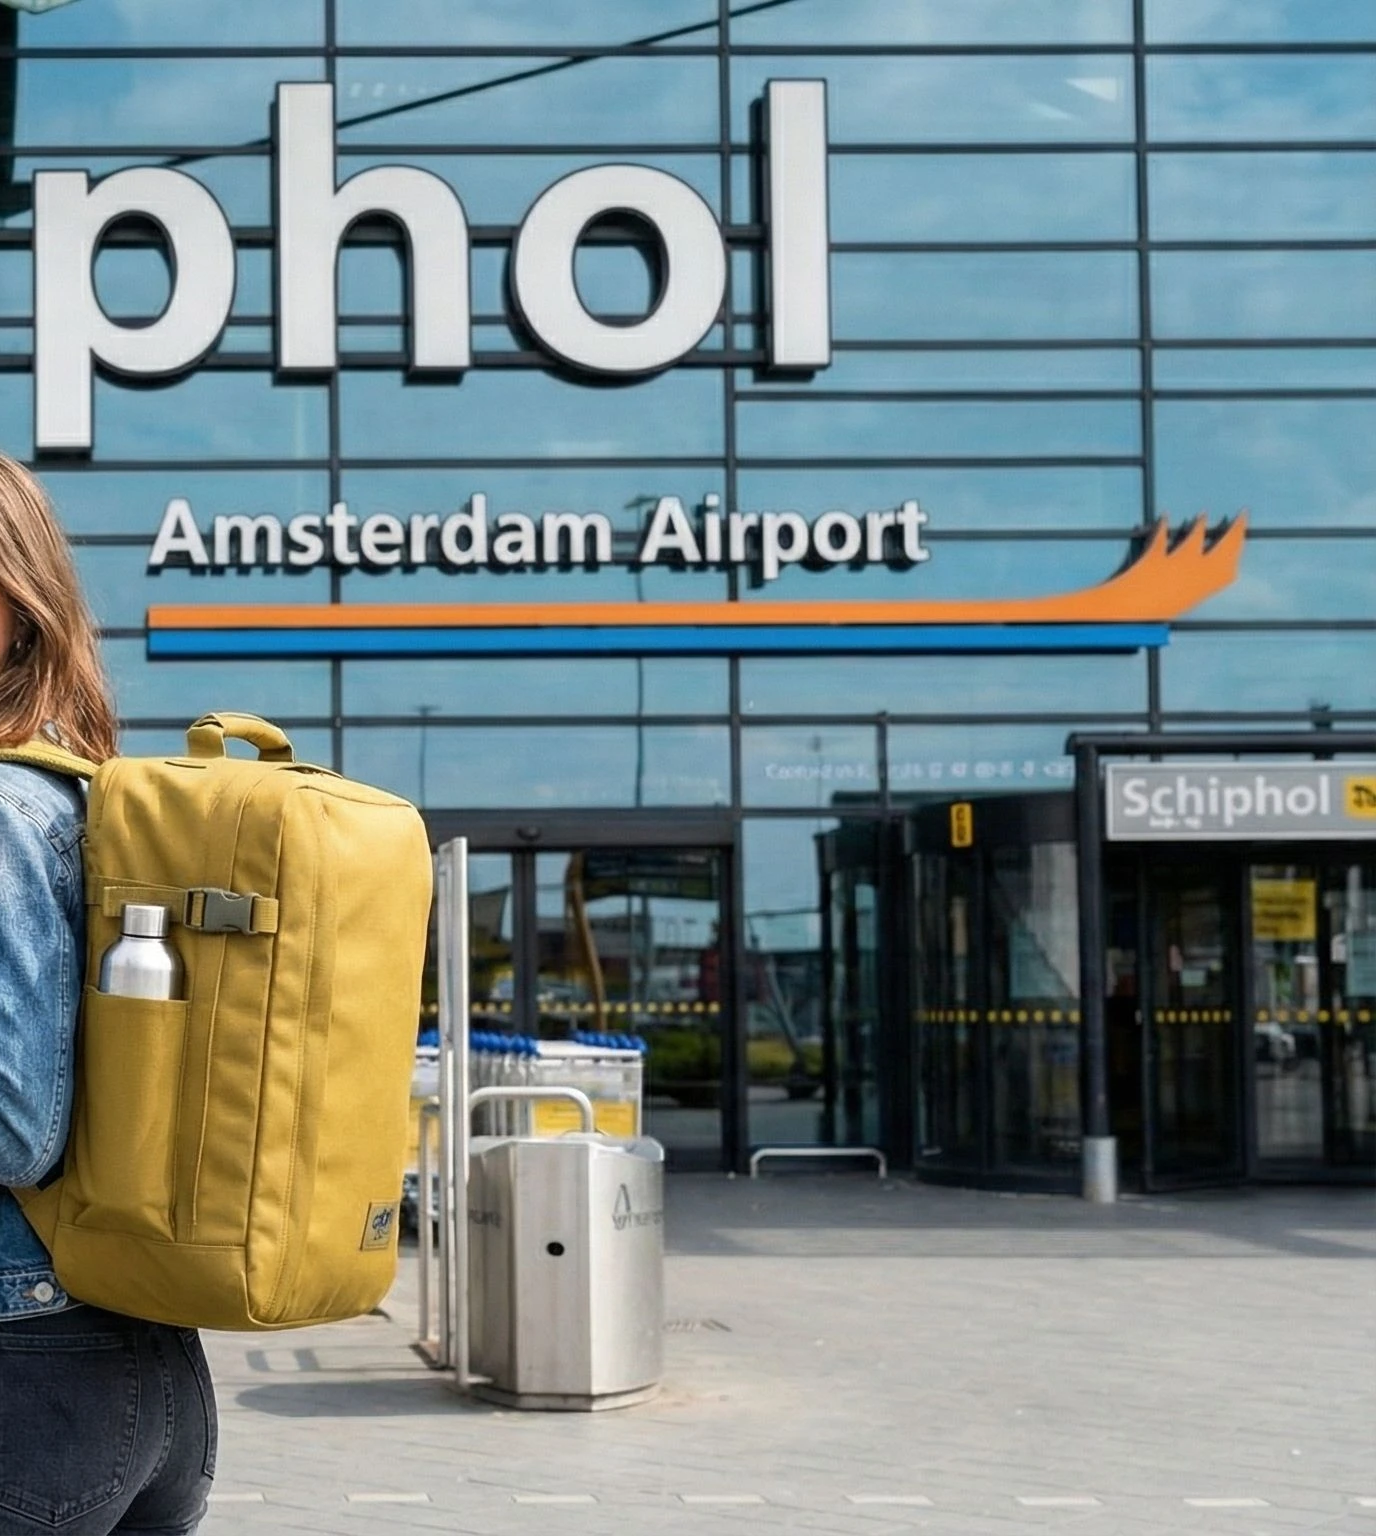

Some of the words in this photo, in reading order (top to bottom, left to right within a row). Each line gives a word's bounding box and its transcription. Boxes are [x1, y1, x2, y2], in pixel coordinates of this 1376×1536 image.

[148, 494, 614, 566] Amsterdam
[640, 495, 929, 581] Airport
[1123, 775, 1330, 827] Schiphol
